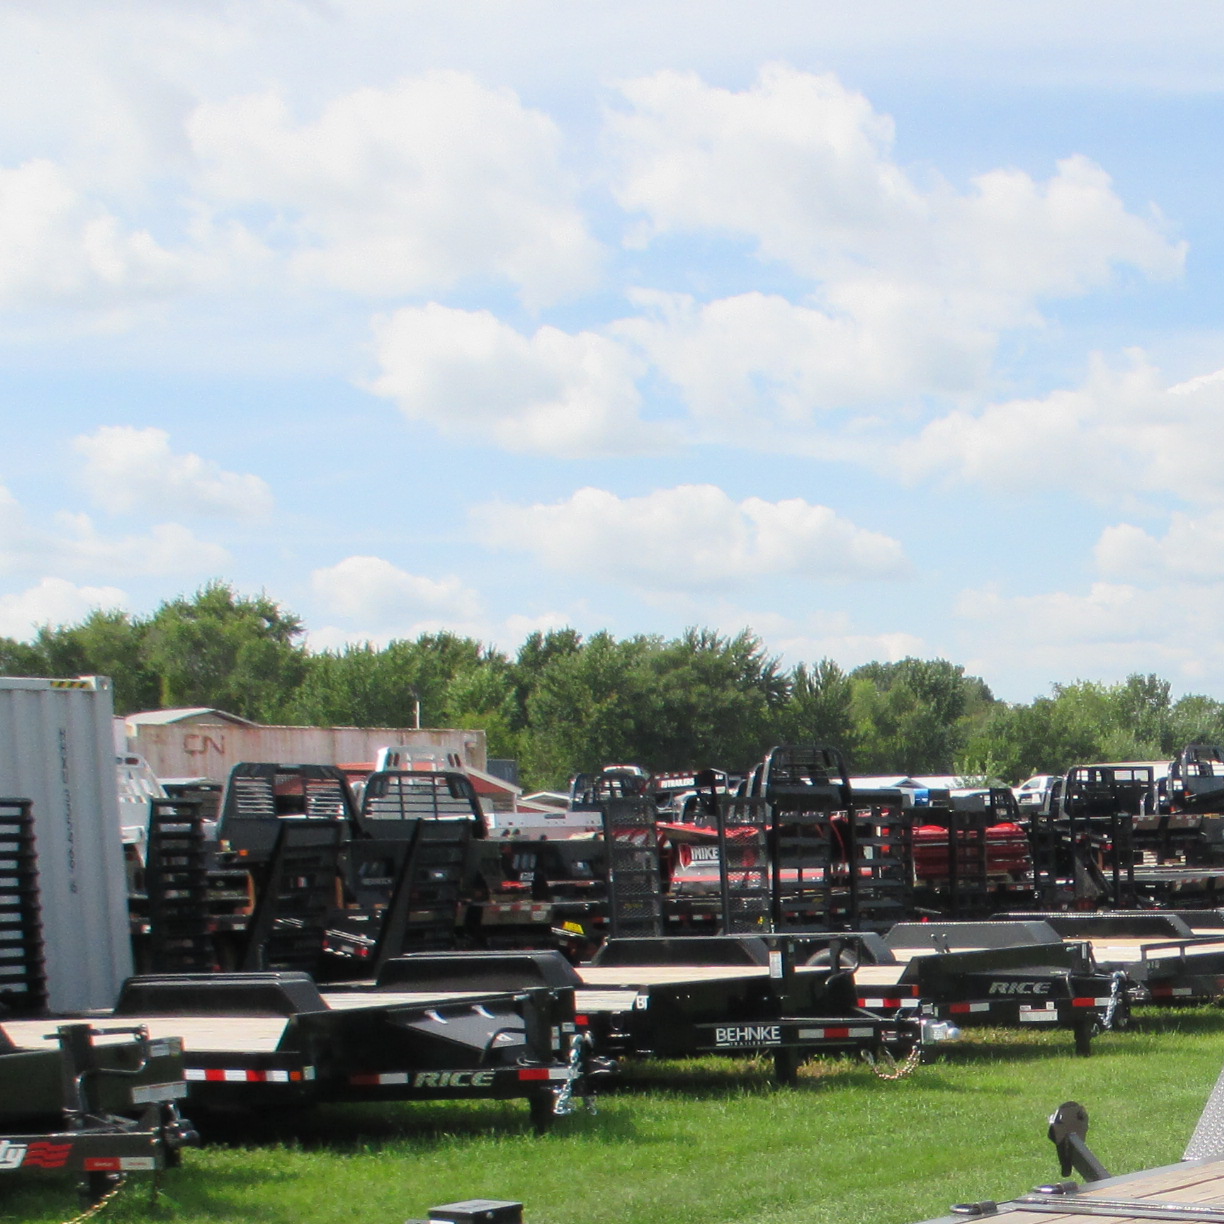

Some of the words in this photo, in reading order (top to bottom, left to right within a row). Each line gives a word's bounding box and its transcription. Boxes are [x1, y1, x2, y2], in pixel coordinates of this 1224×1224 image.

[183, 733, 225, 755] CN
[988, 981, 1052, 995] RICE
[715, 1025, 781, 1042] BEHNKE
[413, 1070, 497, 1088] RICE
